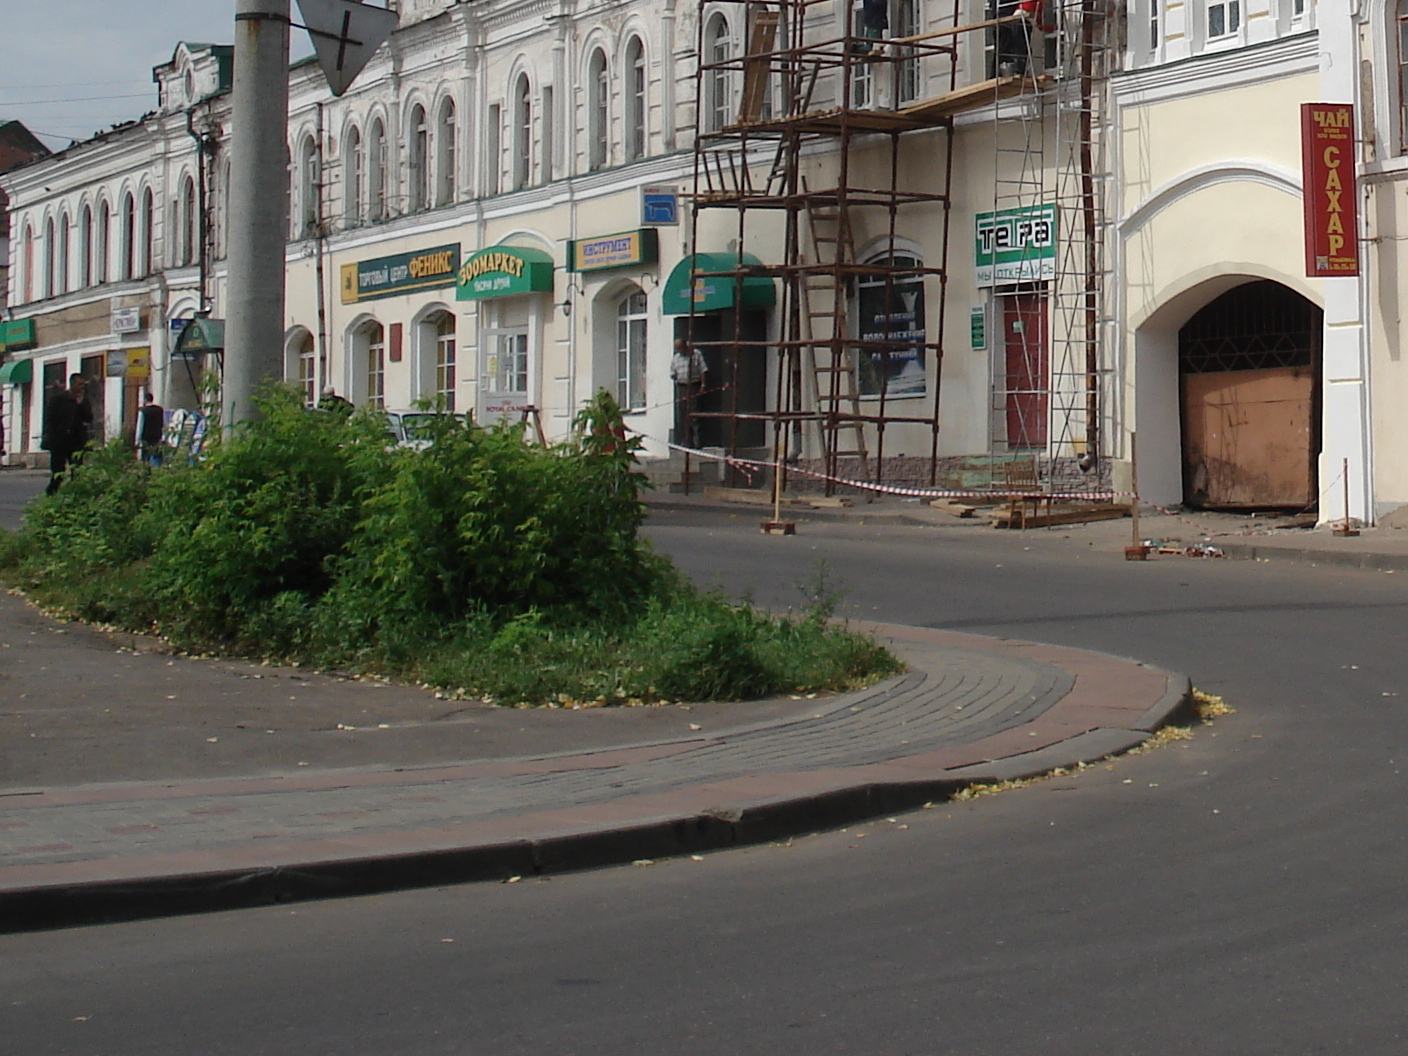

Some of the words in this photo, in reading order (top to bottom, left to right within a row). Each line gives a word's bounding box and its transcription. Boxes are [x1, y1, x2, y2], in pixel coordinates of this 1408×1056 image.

[1313, 109, 1350, 127] ЧАЙ
[1323, 145, 1345, 256] САХАР
[582, 237, 632, 257] ИНСТРУМЕНТ
[408, 250, 454, 278] ФЕНИКС
[459, 252, 525, 286] ЗООМАРКЕТ
[977, 271, 992, 282] МЫ
